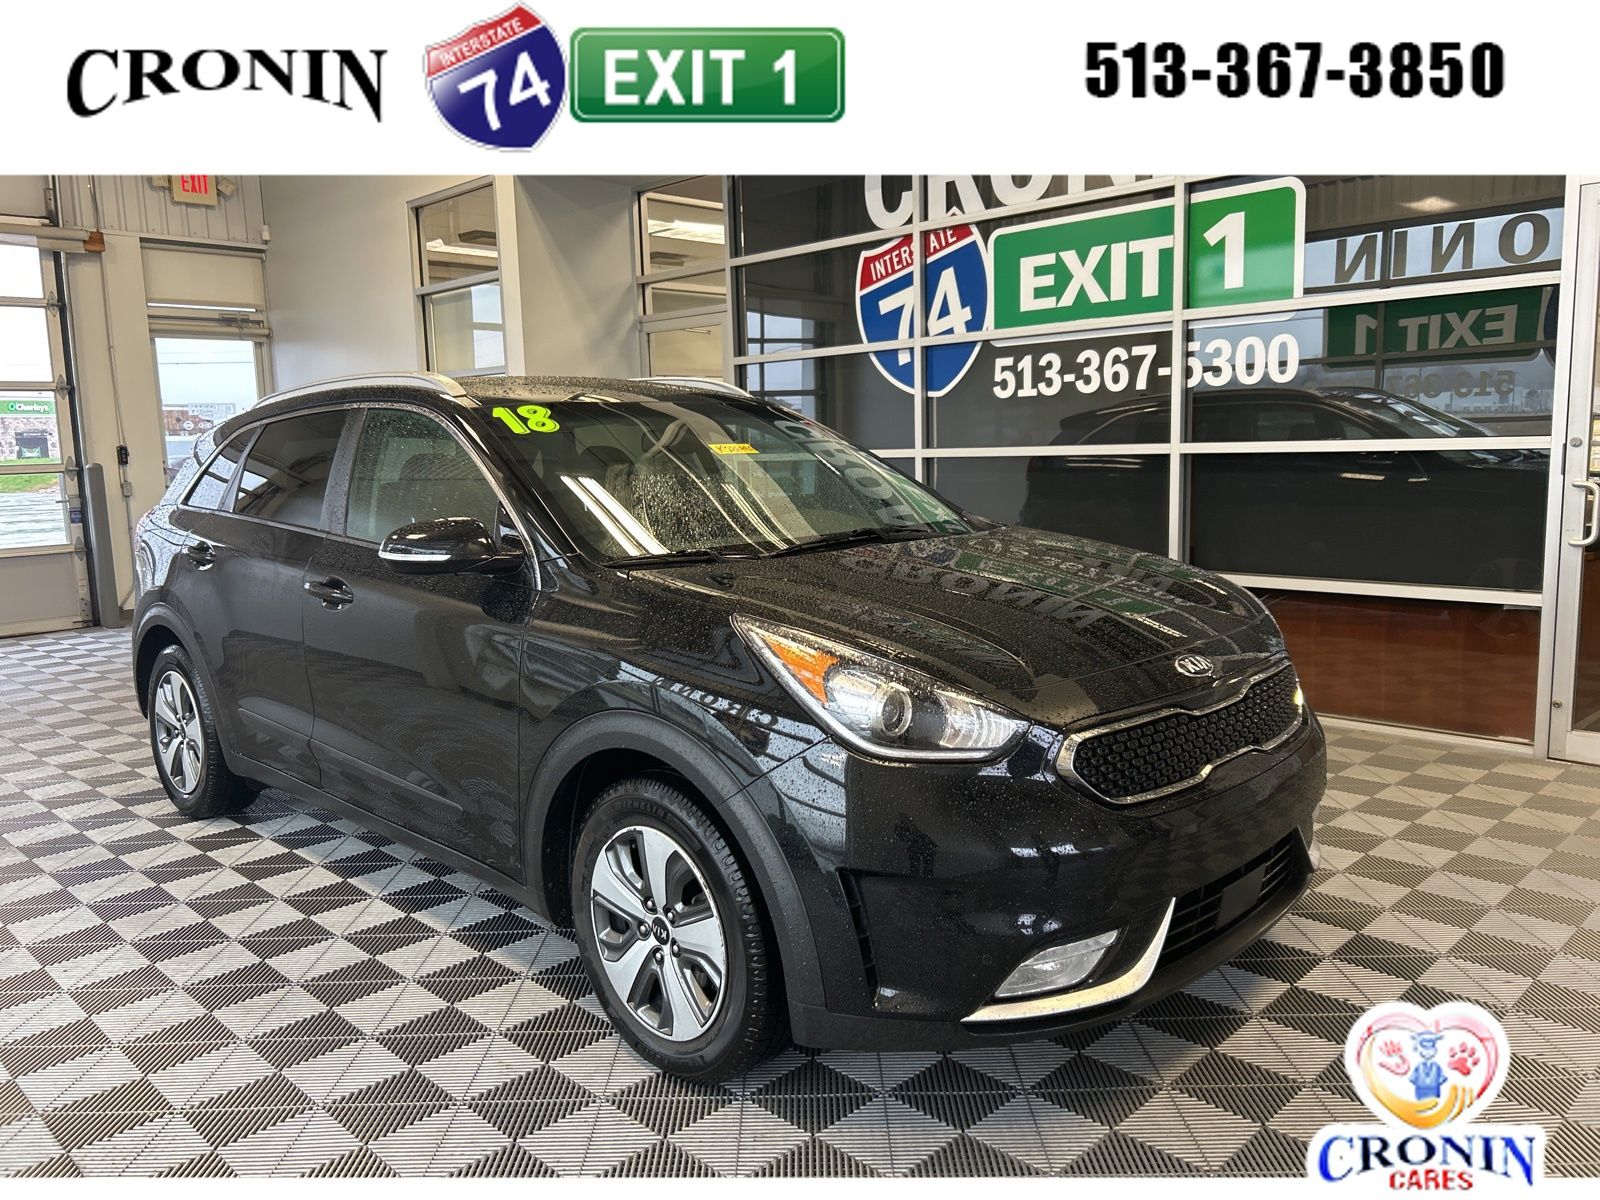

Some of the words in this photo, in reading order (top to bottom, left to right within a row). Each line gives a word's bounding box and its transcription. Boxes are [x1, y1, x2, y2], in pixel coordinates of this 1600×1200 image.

[181, 175, 208, 194] EXIT
[1020, 235, 1175, 312] EXIT
[1203, 211, 1245, 290] 1
[877, 266, 973, 367] 74
[992, 333, 1300, 399] 513-367-5300
[492, 404, 561, 435] 18
[1179, 656, 1212, 673] KIA
[652, 922, 668, 941] KIA
